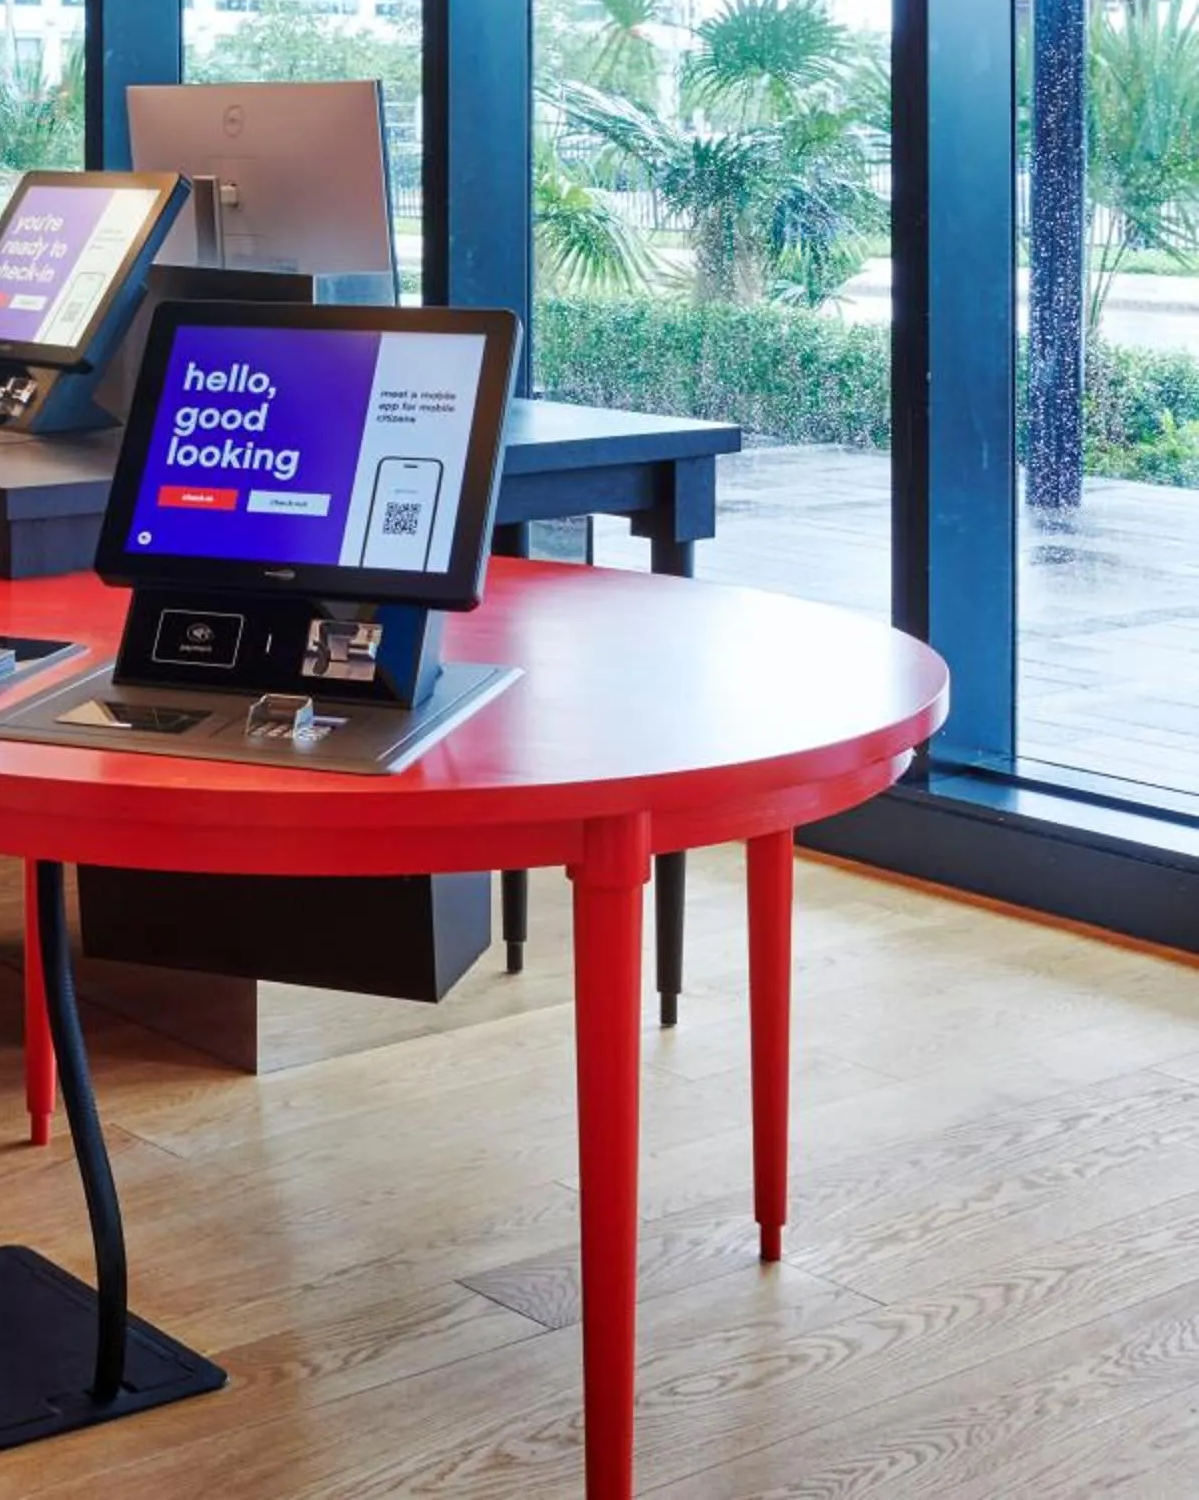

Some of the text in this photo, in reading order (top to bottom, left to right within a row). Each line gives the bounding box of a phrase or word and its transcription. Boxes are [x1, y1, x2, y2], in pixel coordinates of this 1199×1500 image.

[50, 240, 68, 258] to
[183, 361, 276, 399] hello,
[173, 403, 269, 437] good
[166, 436, 300, 481] looking
